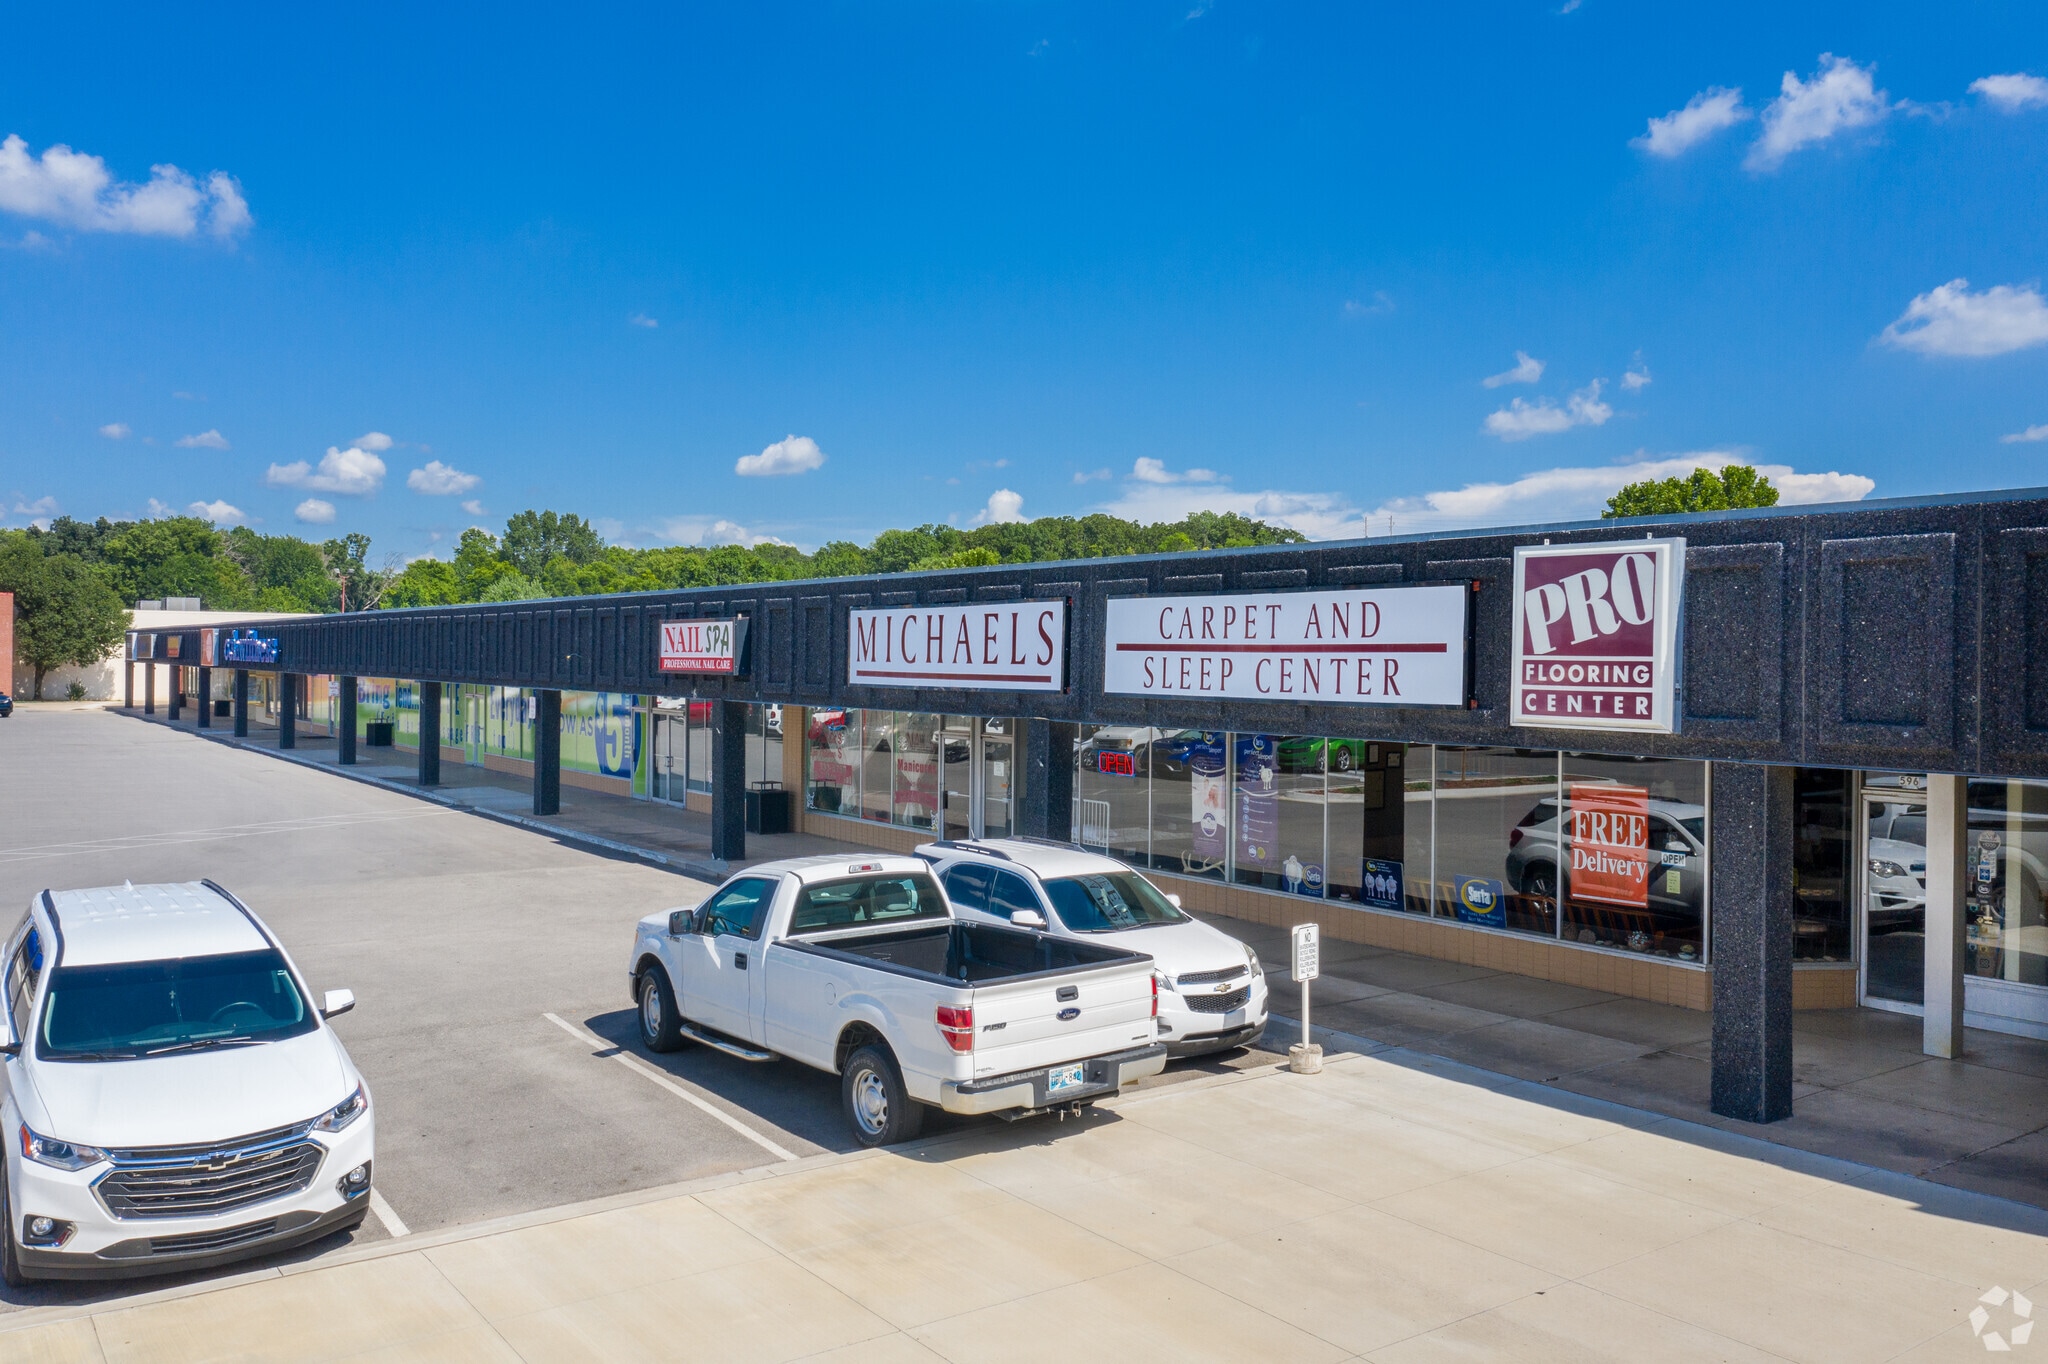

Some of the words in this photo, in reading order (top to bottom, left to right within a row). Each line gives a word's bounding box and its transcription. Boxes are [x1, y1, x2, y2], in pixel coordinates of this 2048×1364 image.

[1525, 553, 1655, 655] PRO
[1159, 604, 1281, 639] CARPET
[1304, 601, 1381, 639] AND
[664, 626, 703, 654] NAIL
[706, 624, 729, 657] SPA
[856, 610, 1054, 666] MICHAELS
[664, 659, 702, 669] PROFESSIONAL
[703, 659, 715, 669] NAIL
[716, 660, 730, 669] CARE
[1143, 656, 1234, 691] SLEEP
[1255, 658, 1401, 696] CENTER
[1525, 664, 1650, 684] FLOORING
[1525, 693, 1648, 715] CENTER
[560, 713, 576, 734] OW
[580, 716, 593, 737] AS
[1100, 752, 1133, 776] OPEN
[1900, 776, 1919, 786] 596
[1573, 810, 1647, 849] FREE
[1573, 848, 1648, 884] Delivery
[1663, 853, 1685, 865] OPEN
[1306, 870, 1320, 883] Serta
[1467, 886, 1491, 905] Serta
[1304, 932, 1312, 943] NO
